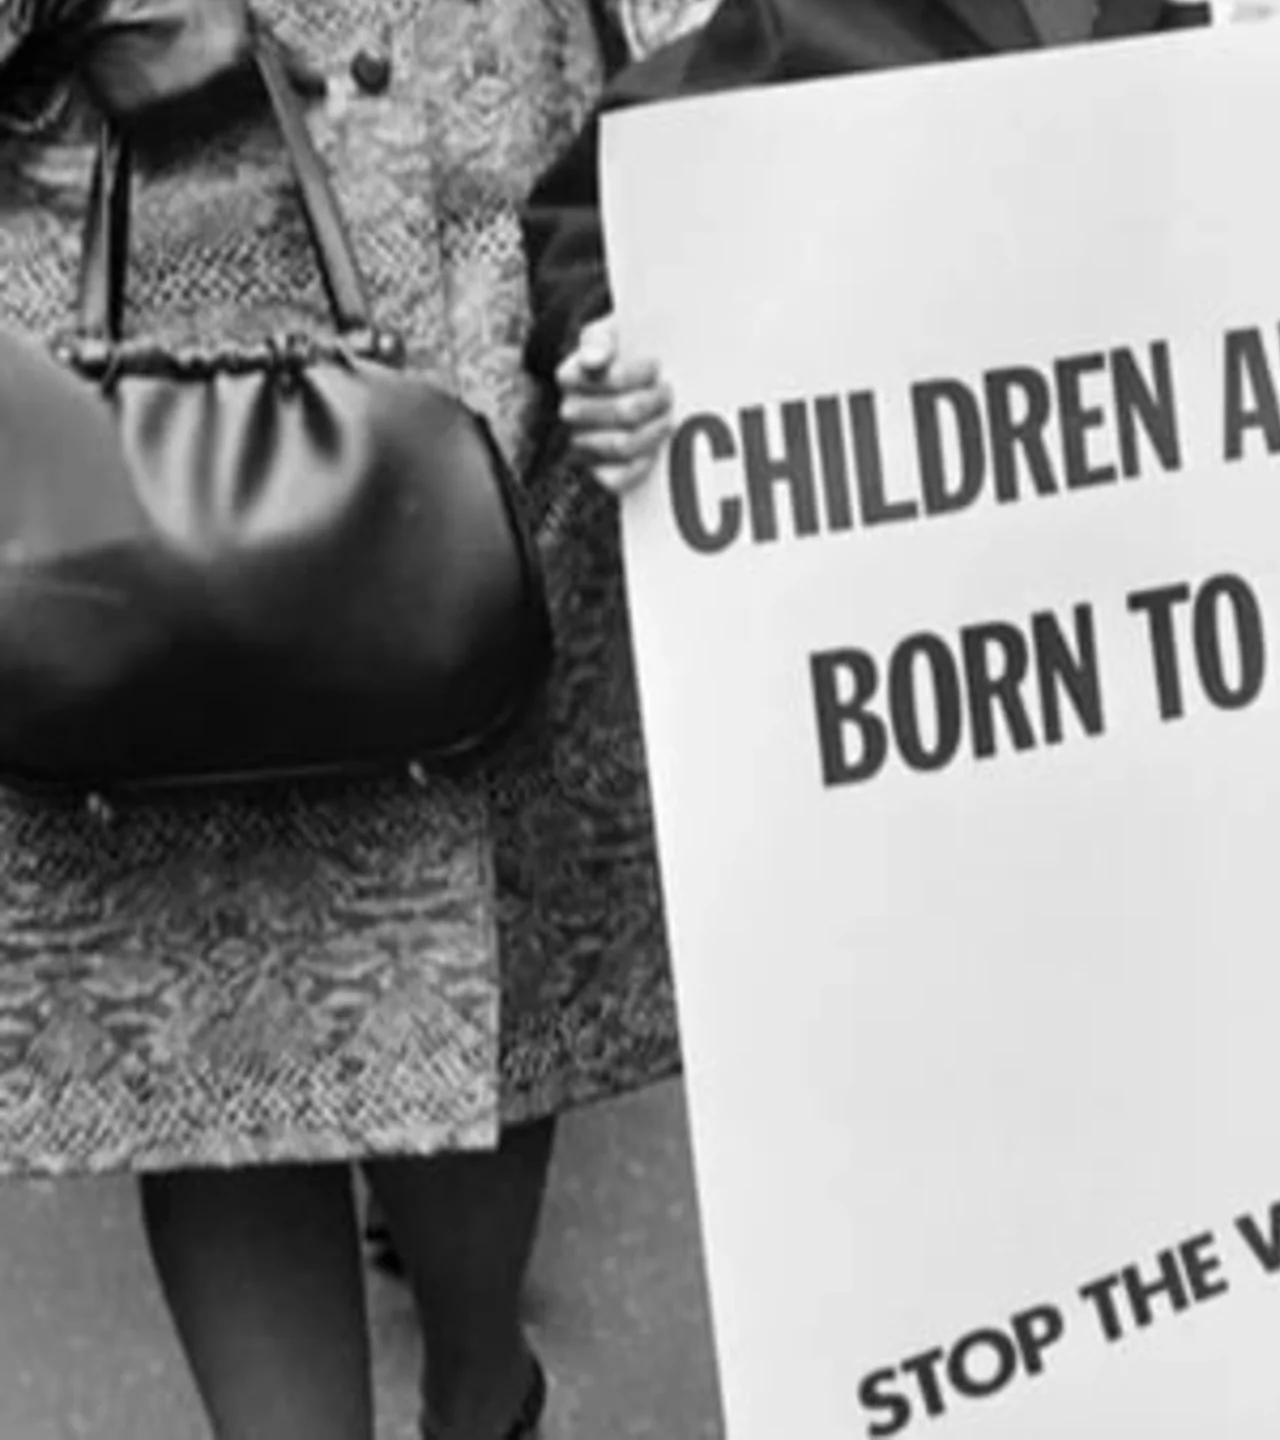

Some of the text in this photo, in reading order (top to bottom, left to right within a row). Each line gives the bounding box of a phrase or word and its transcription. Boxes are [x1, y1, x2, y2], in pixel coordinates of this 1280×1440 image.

[668, 340, 1180, 554] CHILDREN
[810, 603, 1104, 787] BORN
[1127, 574, 1264, 720] TO
[858, 1305, 1063, 1439] STOP
[1079, 1232, 1228, 1341] THE
